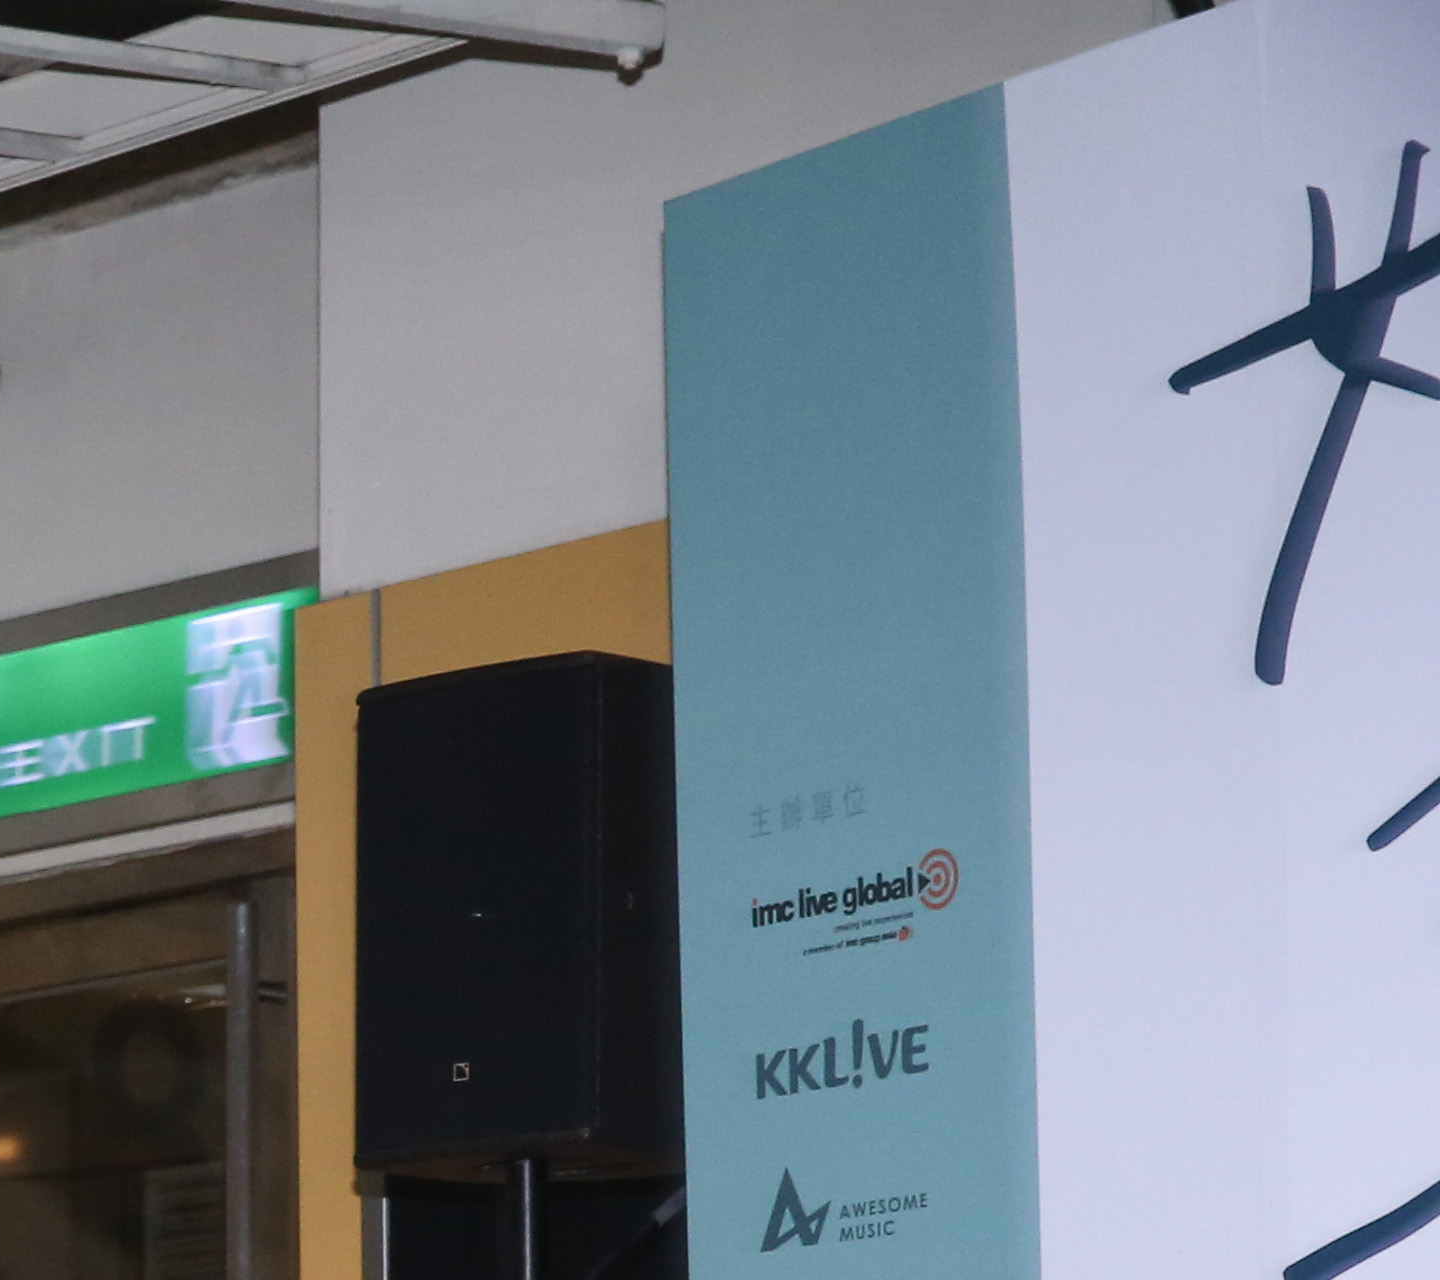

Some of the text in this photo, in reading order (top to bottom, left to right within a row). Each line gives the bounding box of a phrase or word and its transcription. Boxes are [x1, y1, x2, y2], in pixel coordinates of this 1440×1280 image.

[752, 866, 913, 928] imc live global
[839, 1191, 929, 1221] AWESOME
[839, 1220, 895, 1243] MUSIC
